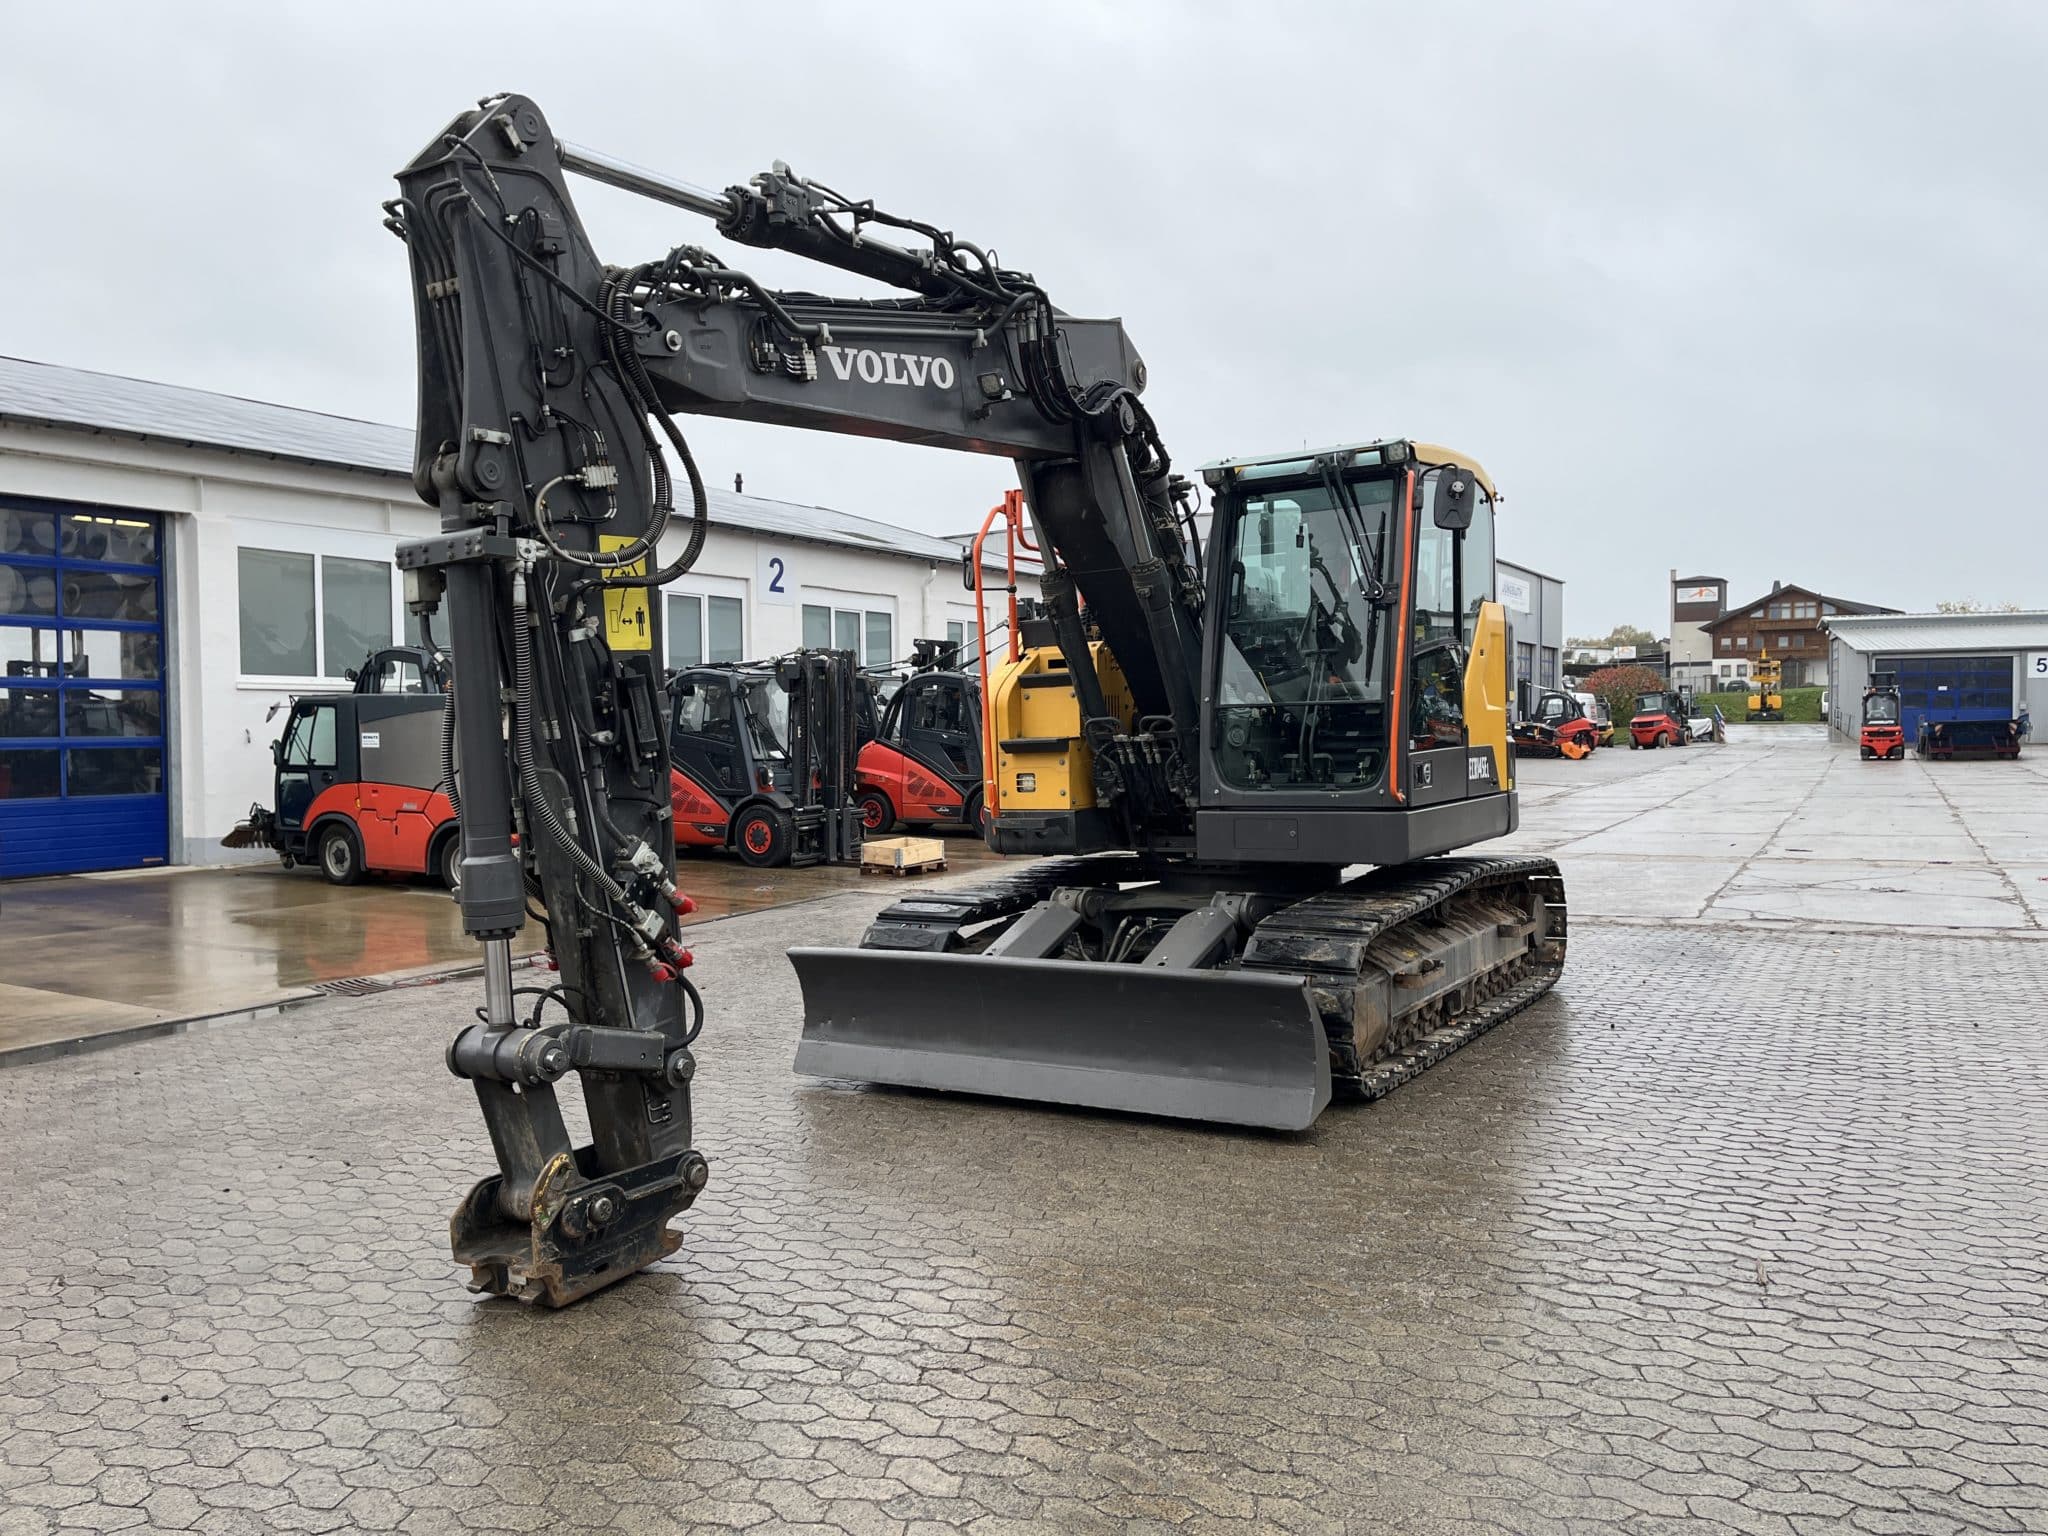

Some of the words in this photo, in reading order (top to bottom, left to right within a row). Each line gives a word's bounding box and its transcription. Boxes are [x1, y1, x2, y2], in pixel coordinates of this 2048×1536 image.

[821, 345, 954, 389] VOLVO
[769, 557, 785, 593] 2
[2036, 657, 2047, 673] 5
